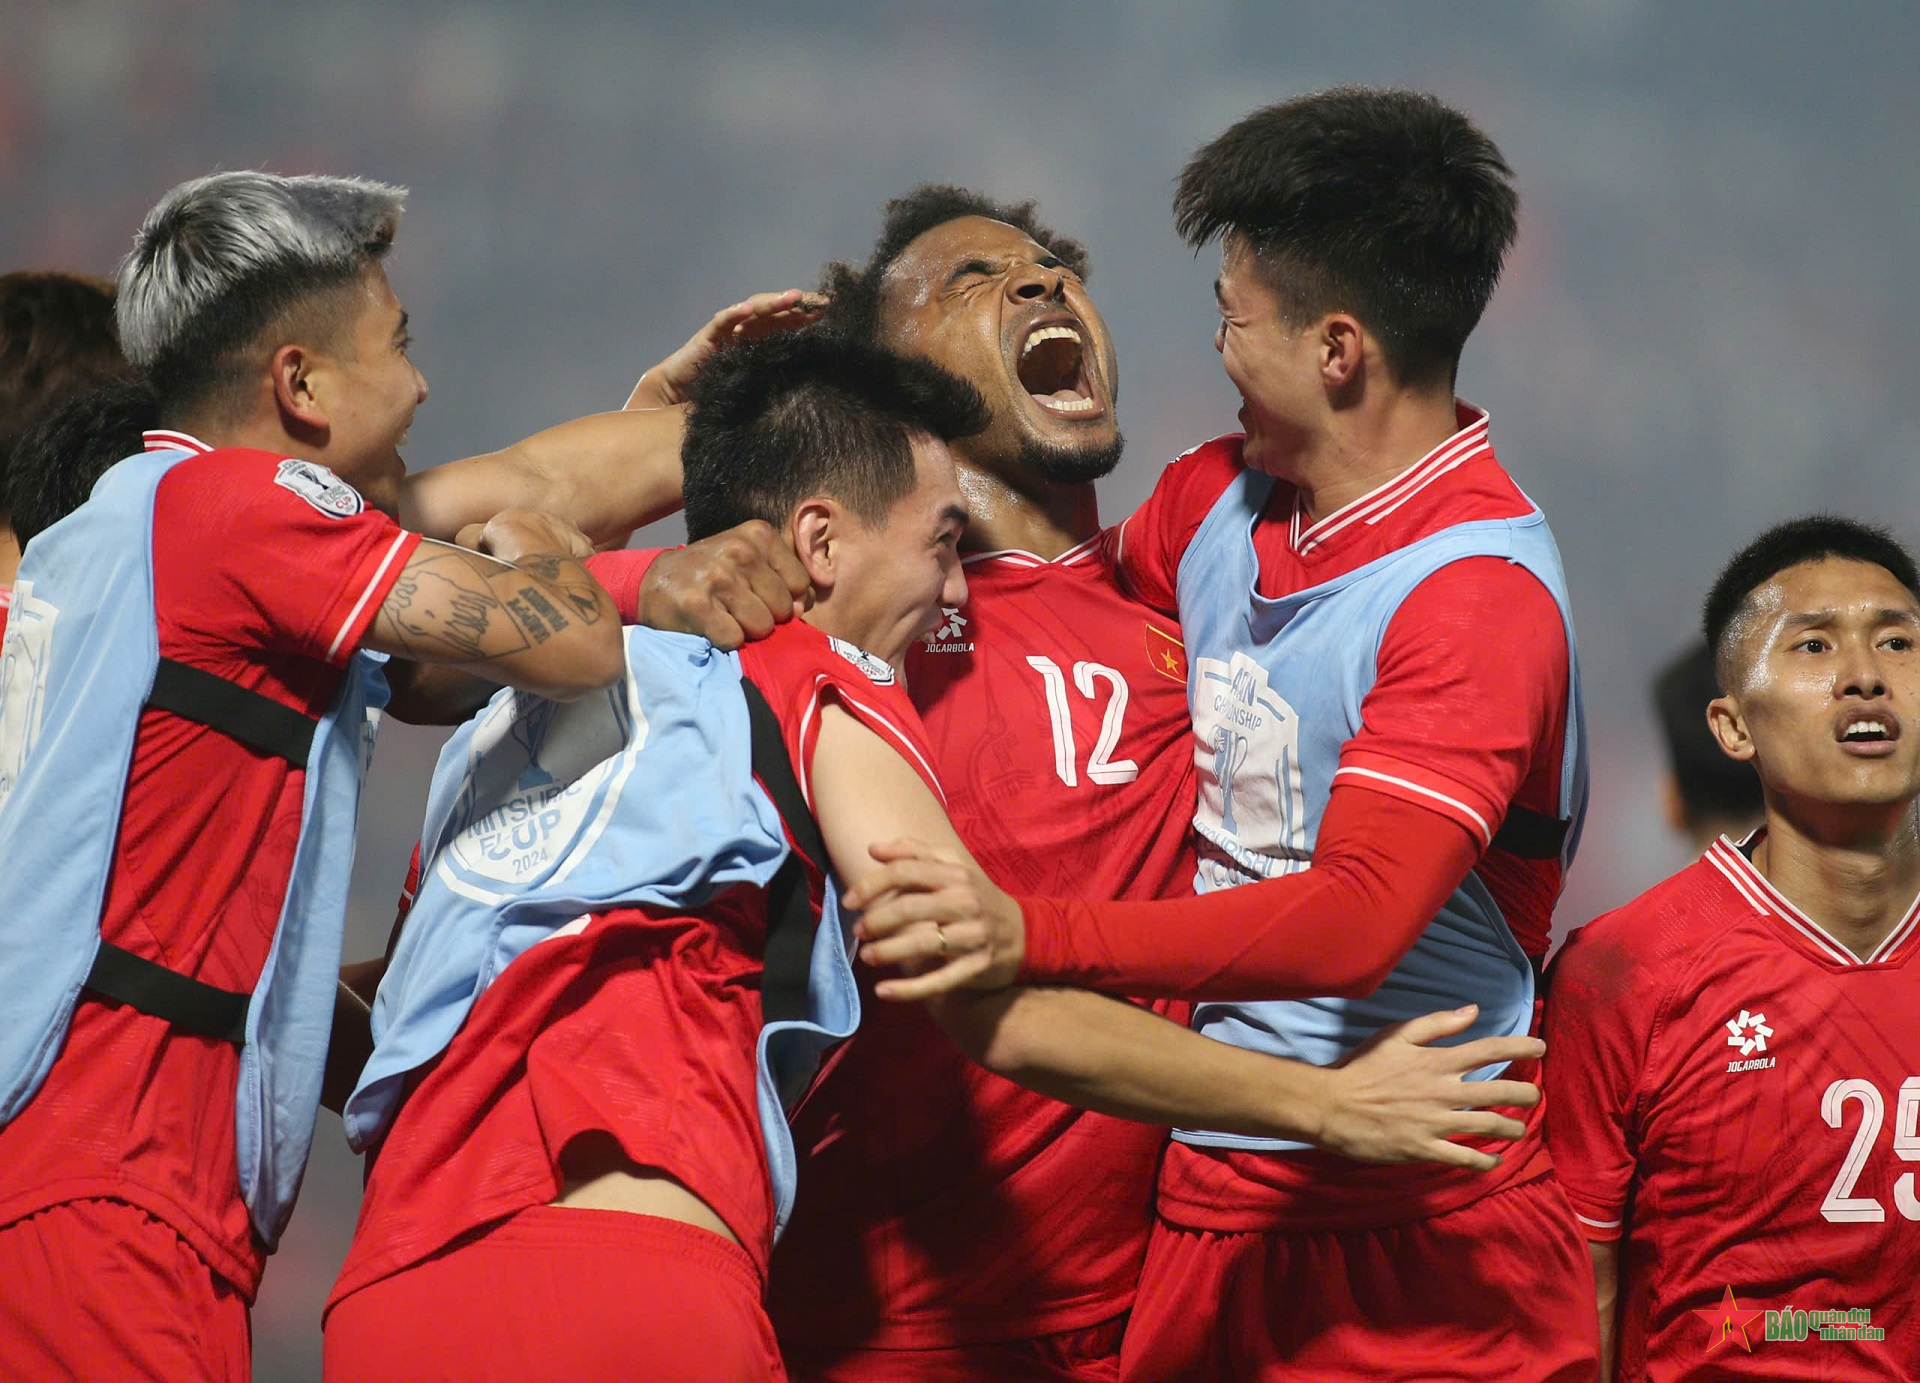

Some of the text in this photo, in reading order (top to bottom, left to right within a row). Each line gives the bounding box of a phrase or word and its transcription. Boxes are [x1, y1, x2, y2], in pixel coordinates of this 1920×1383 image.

[925, 642, 975, 653] JOGARBOLA
[1026, 655, 1139, 787] 12
[512, 848, 548, 876] 2024
[1726, 1056, 1776, 1073] JOGARBOLA
